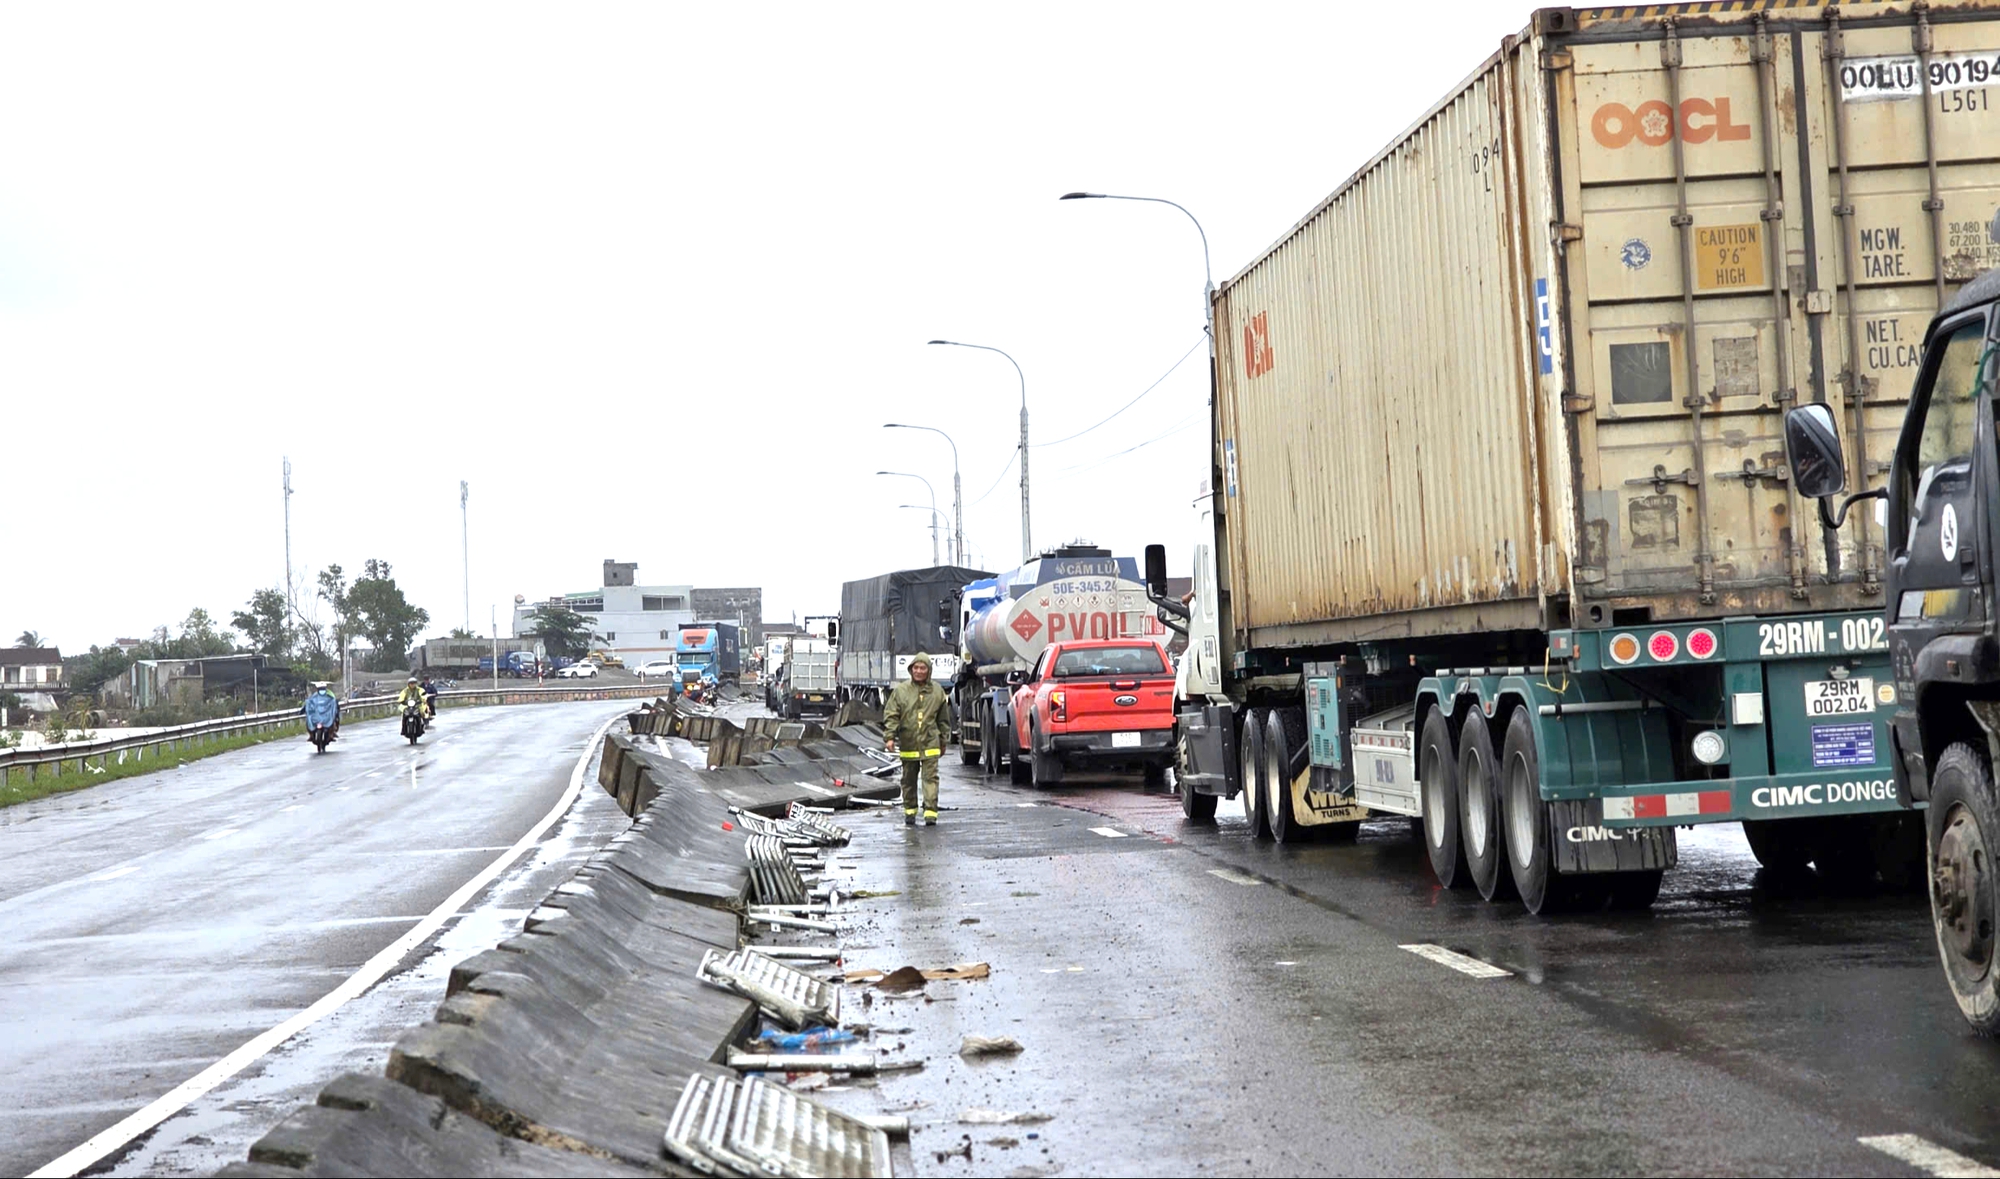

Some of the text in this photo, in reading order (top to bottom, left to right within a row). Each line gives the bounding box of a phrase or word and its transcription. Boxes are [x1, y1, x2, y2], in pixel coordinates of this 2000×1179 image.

[1840, 64, 1914, 89] OOLU
[1941, 88, 1988, 113] L5G1
[1591, 97, 1751, 149] OOCL
[1700, 227, 1757, 246] CAUTION
[1948, 221, 1980, 234] 30.480
[1860, 228, 1905, 252] MGW.
[1949, 234, 1981, 247] 67.200
[1716, 268, 1747, 286] HIGH
[1862, 254, 1911, 278] TARE.
[1866, 319, 1904, 343] NET.
[1759, 620, 1825, 655] 29RM
[1819, 680, 1859, 697] 29RM
[1813, 697, 1868, 714] 002.04
[1751, 784, 1823, 807] CIMC
[1321, 808, 1351, 818] TURNS
